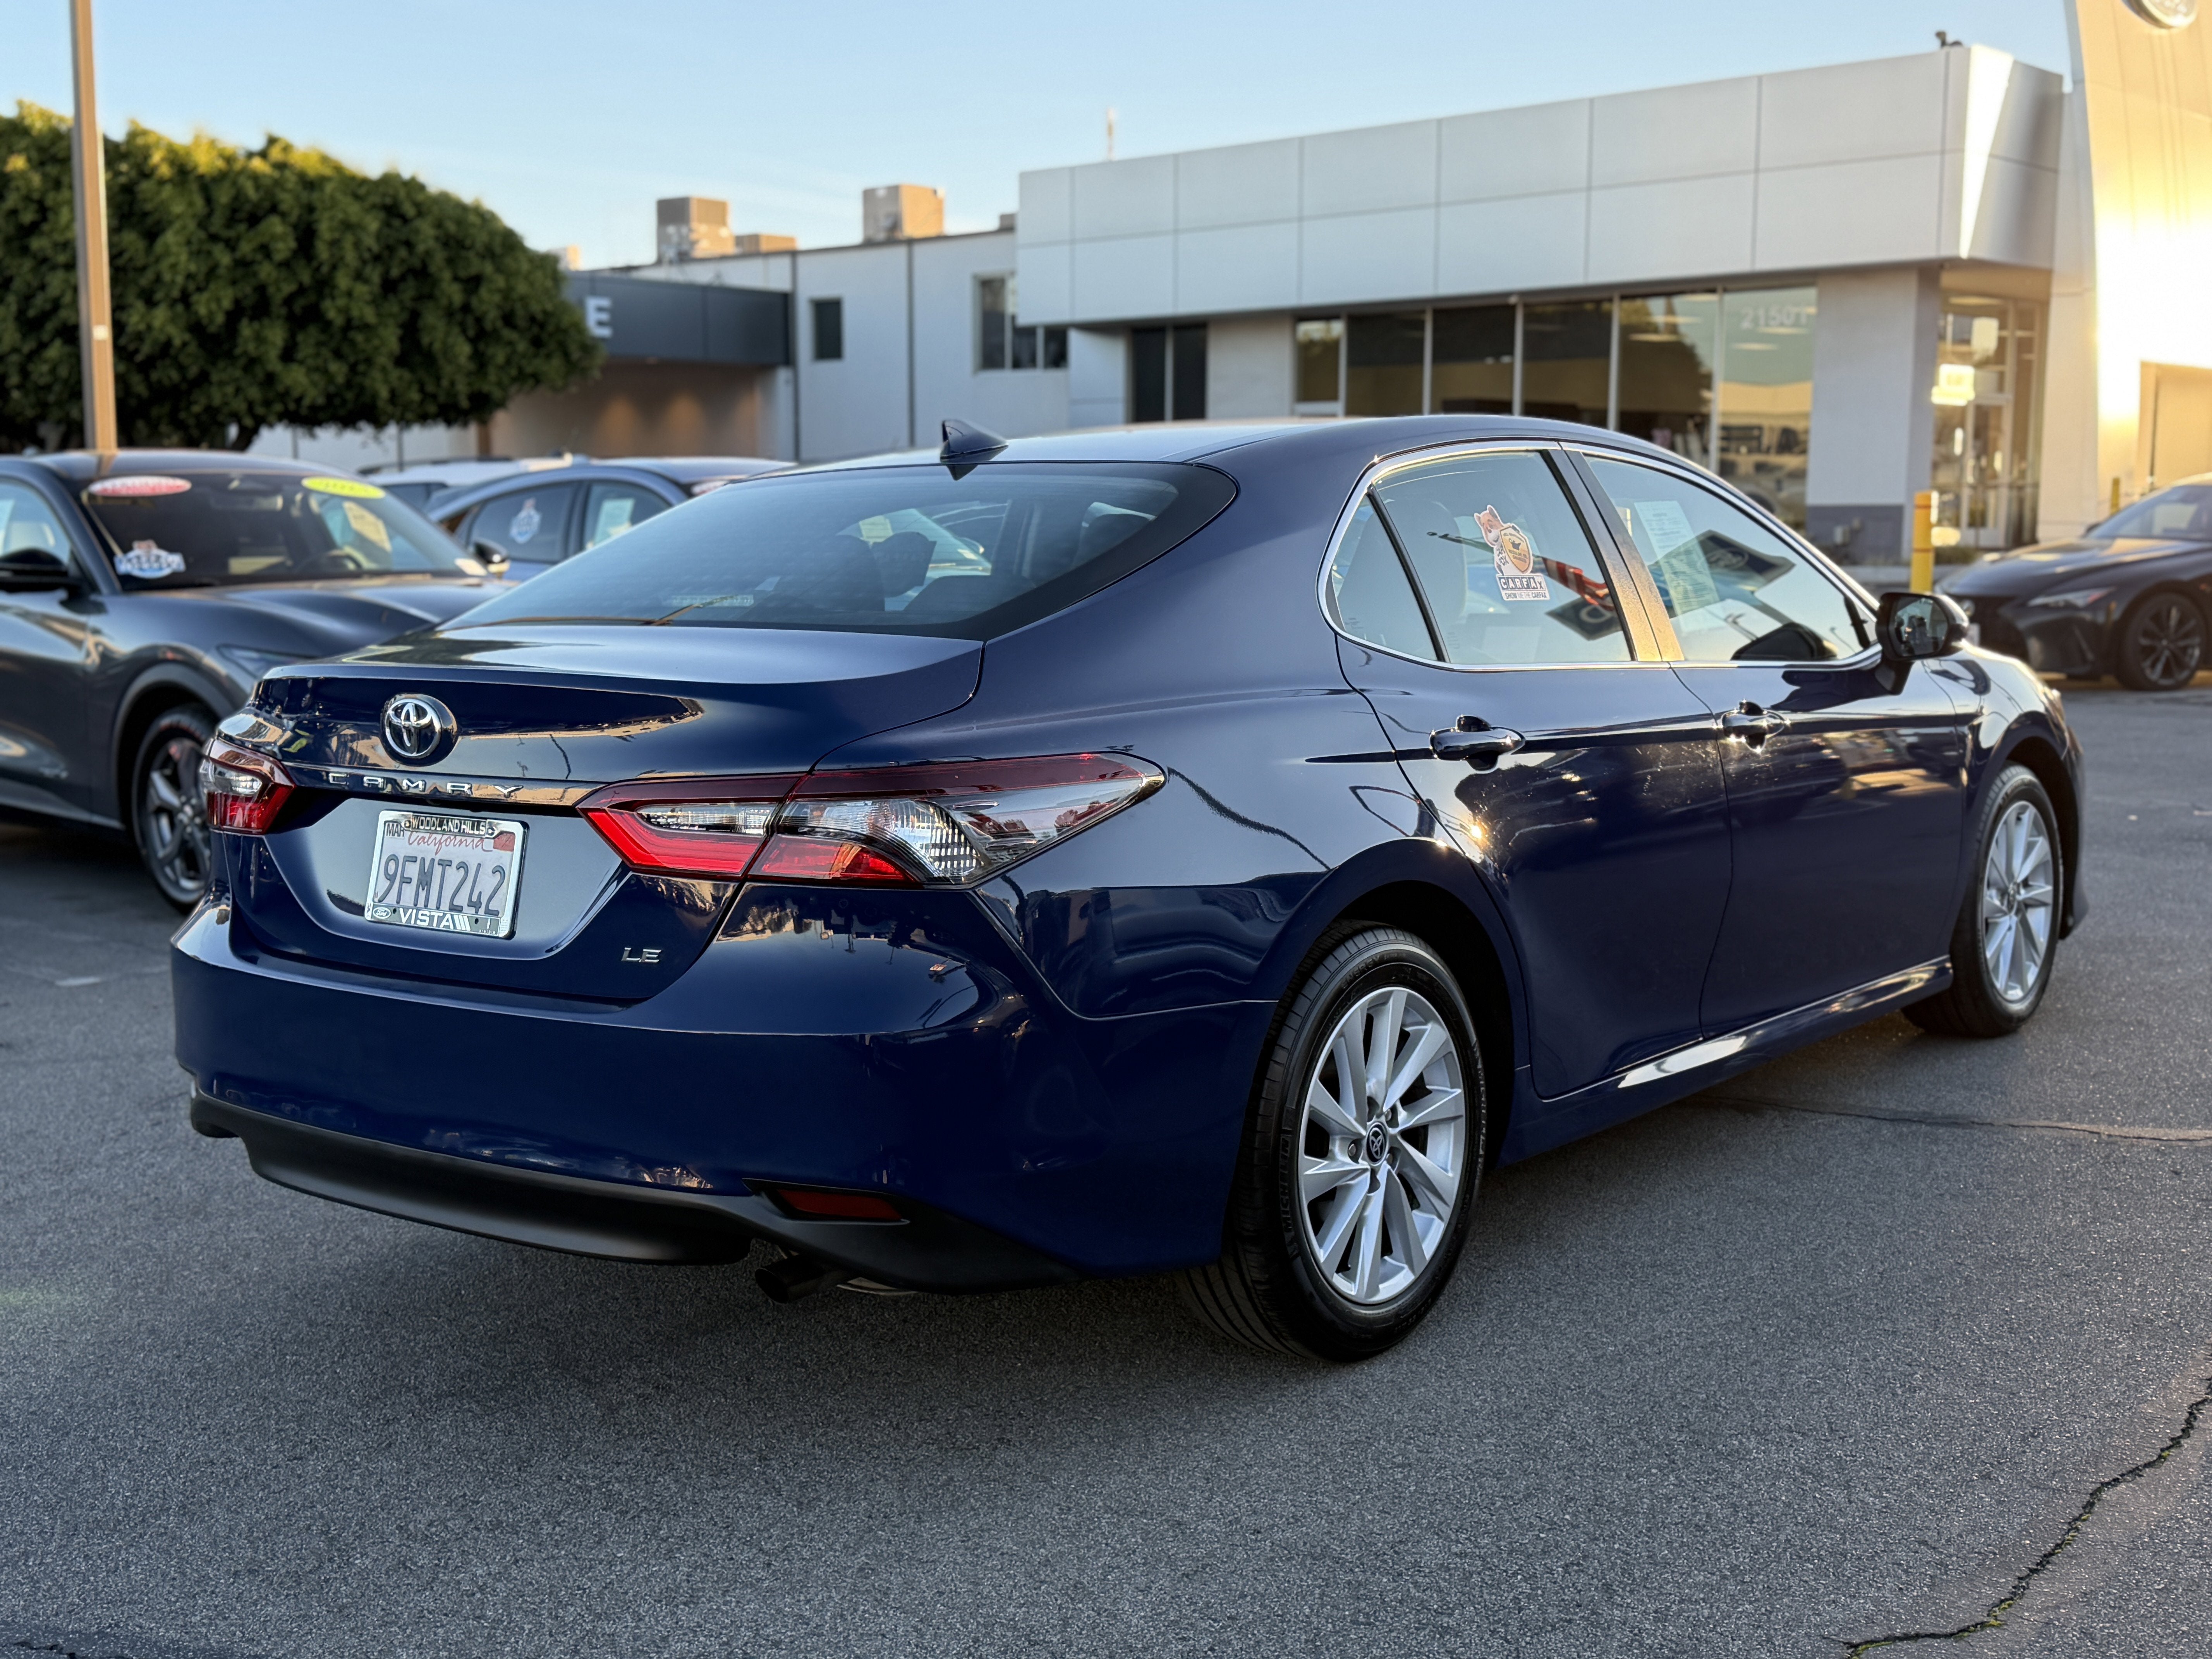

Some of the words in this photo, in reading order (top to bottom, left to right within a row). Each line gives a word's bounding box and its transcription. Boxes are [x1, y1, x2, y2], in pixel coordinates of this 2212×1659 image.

[1500, 577, 1544, 590] CARFAX
[328, 773, 524, 798] CAMRY
[412, 816, 460, 833] WOODLAND
[460, 820, 486, 835] HILLS
[407, 831, 493, 855] California
[378, 854, 506, 916] 9FMT242
[399, 907, 453, 929] VISTA
[621, 947, 662, 963] LE
[1280, 1137, 1293, 1233] MICHELIN
